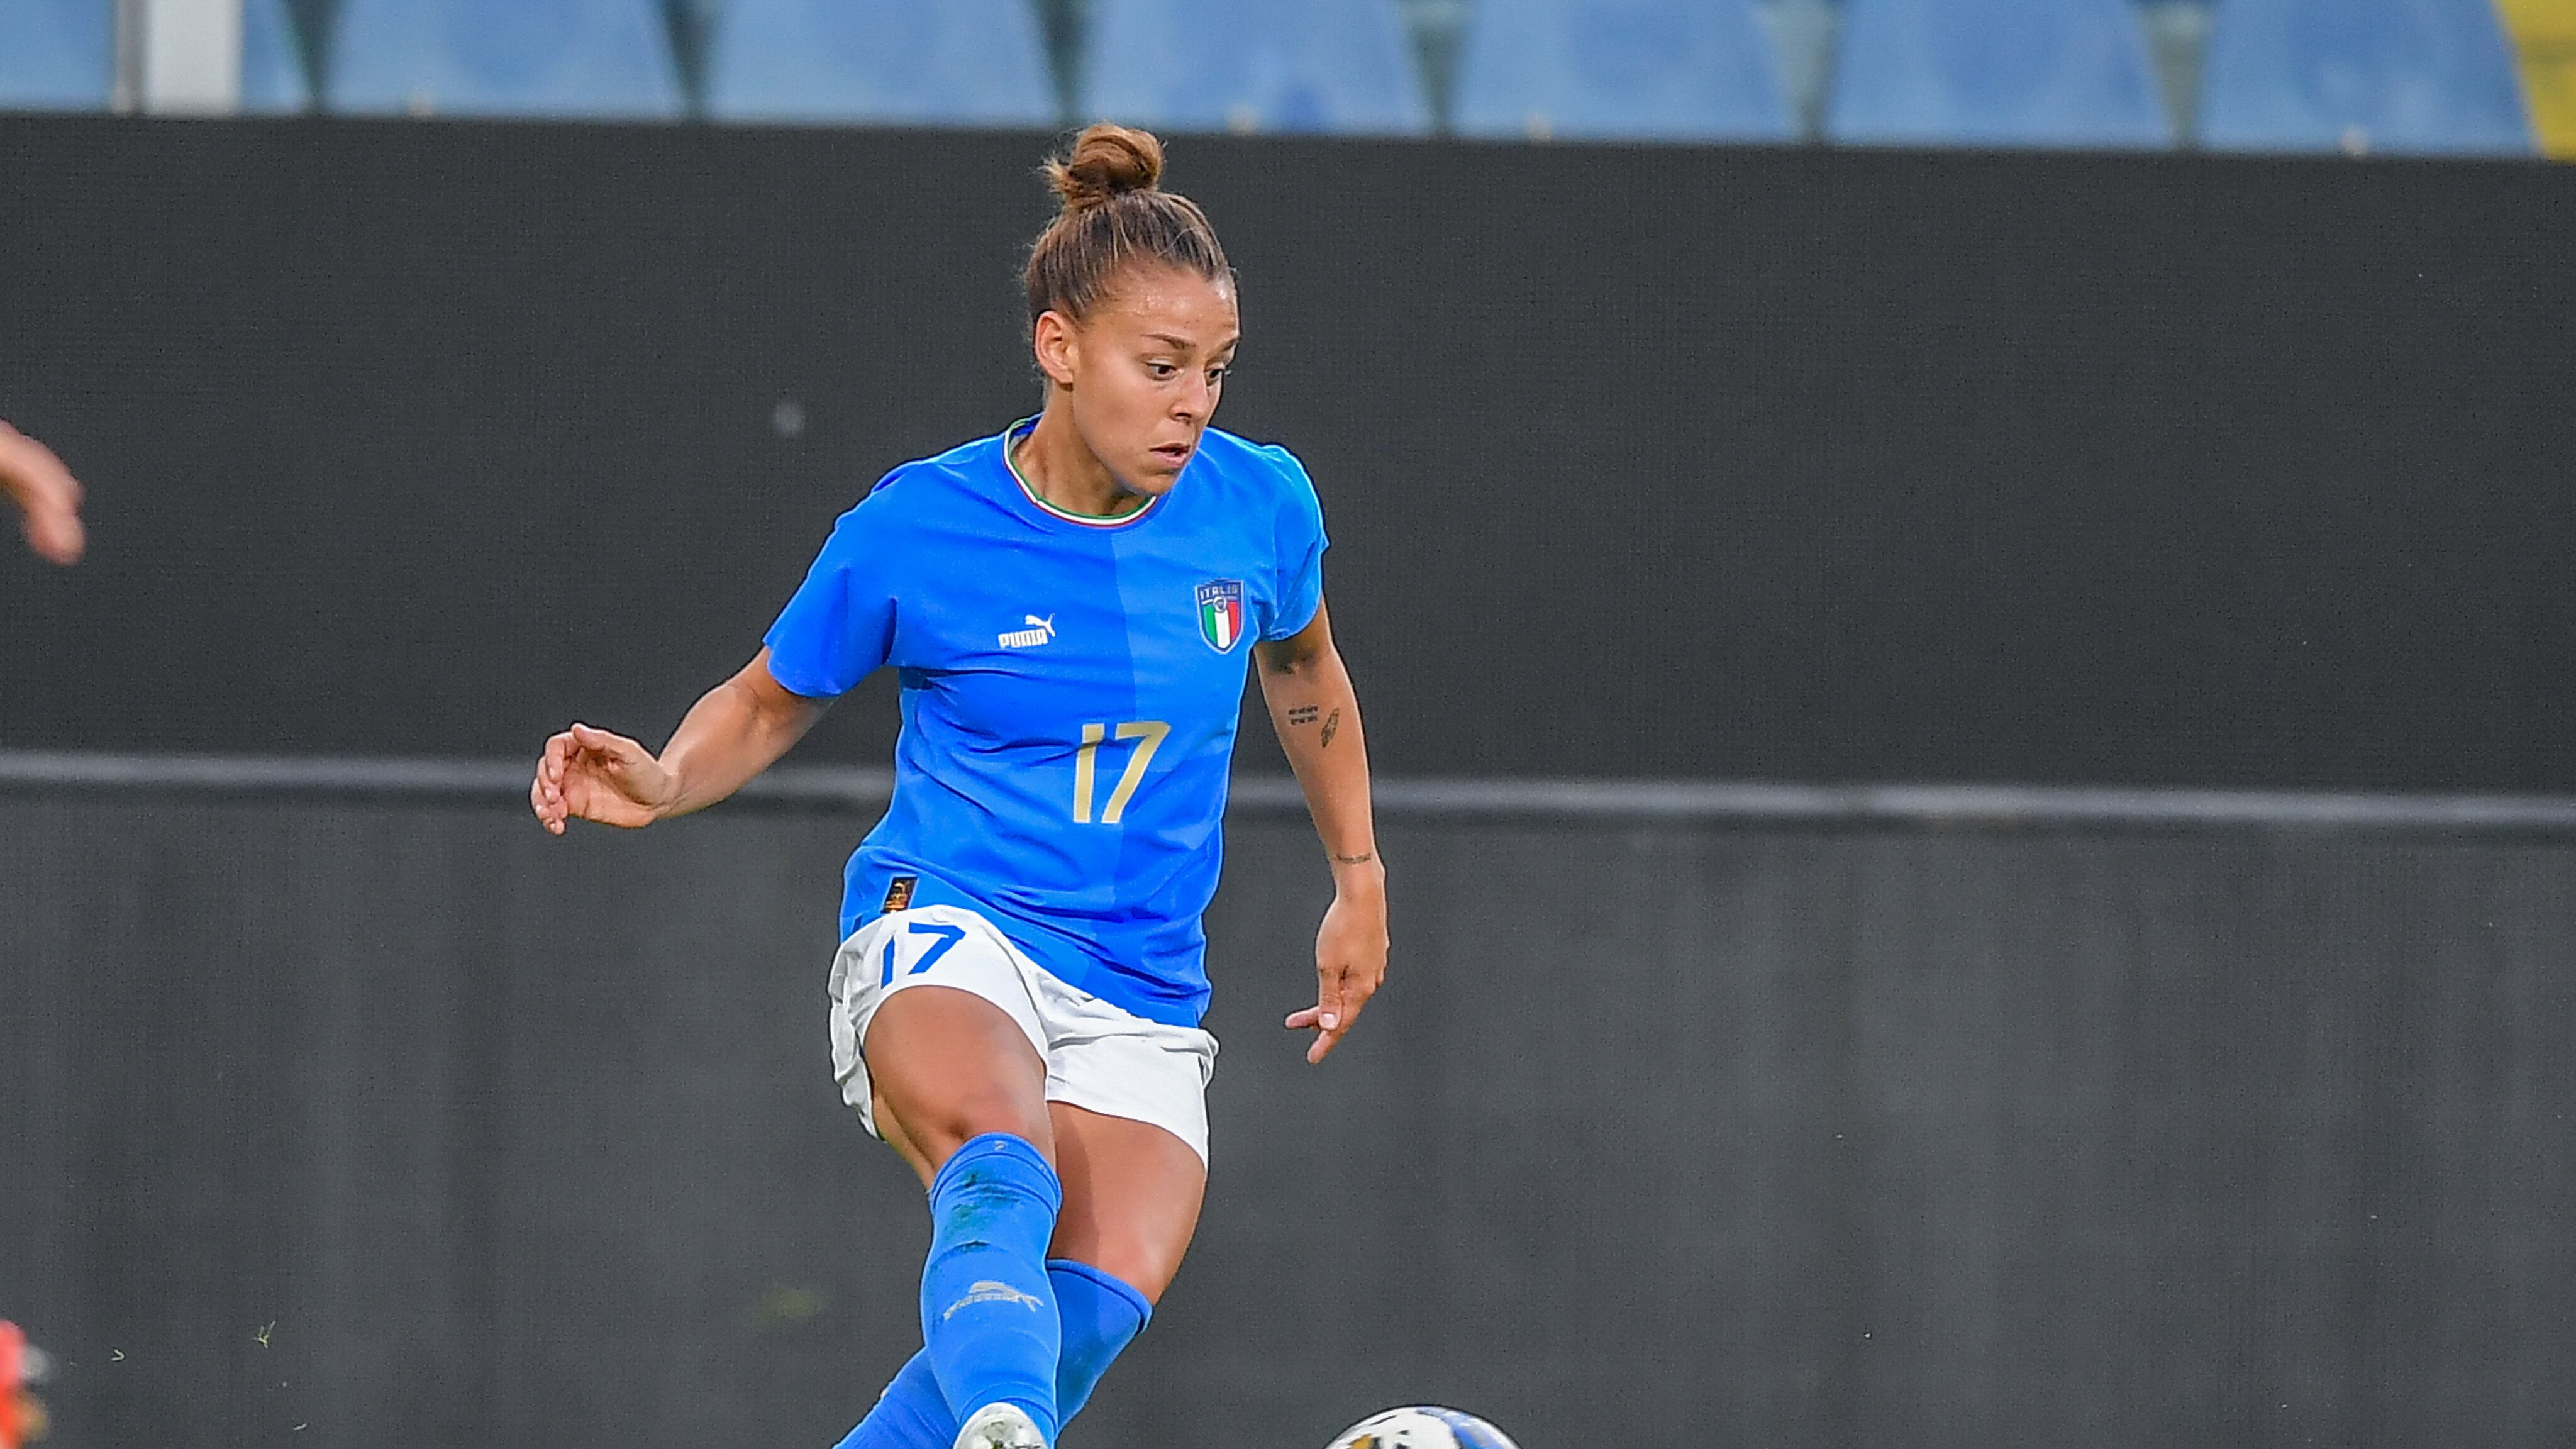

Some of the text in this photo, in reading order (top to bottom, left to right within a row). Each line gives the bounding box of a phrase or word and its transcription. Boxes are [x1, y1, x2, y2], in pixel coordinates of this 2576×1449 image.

[1199, 584, 1238, 600] ITALIA
[998, 628, 1048, 649] PUMA
[1073, 721, 1172, 823] 17
[880, 921, 967, 990] 17
